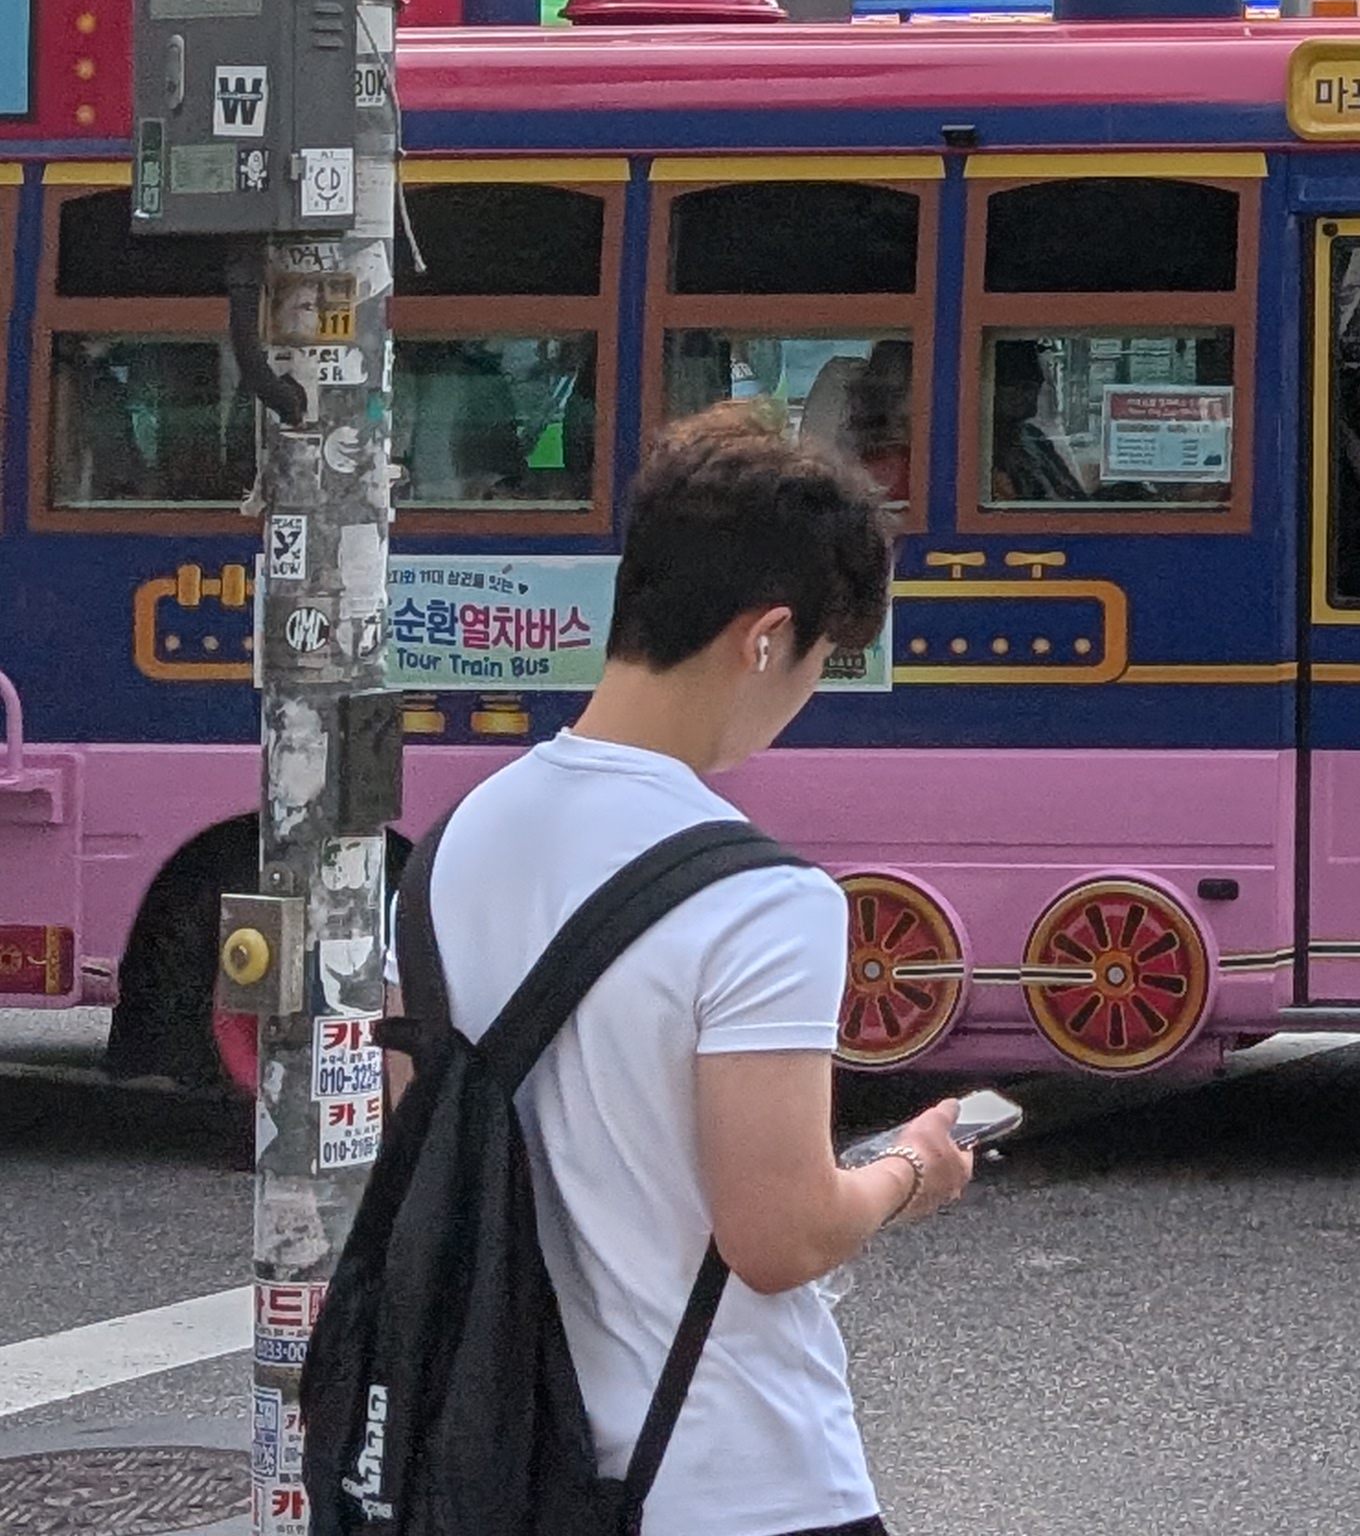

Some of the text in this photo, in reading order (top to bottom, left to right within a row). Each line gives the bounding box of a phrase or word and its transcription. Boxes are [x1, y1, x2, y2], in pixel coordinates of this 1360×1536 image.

[388, 596, 591, 652] 순환열차버스
[397, 648, 549, 679] Tour Train Bus
